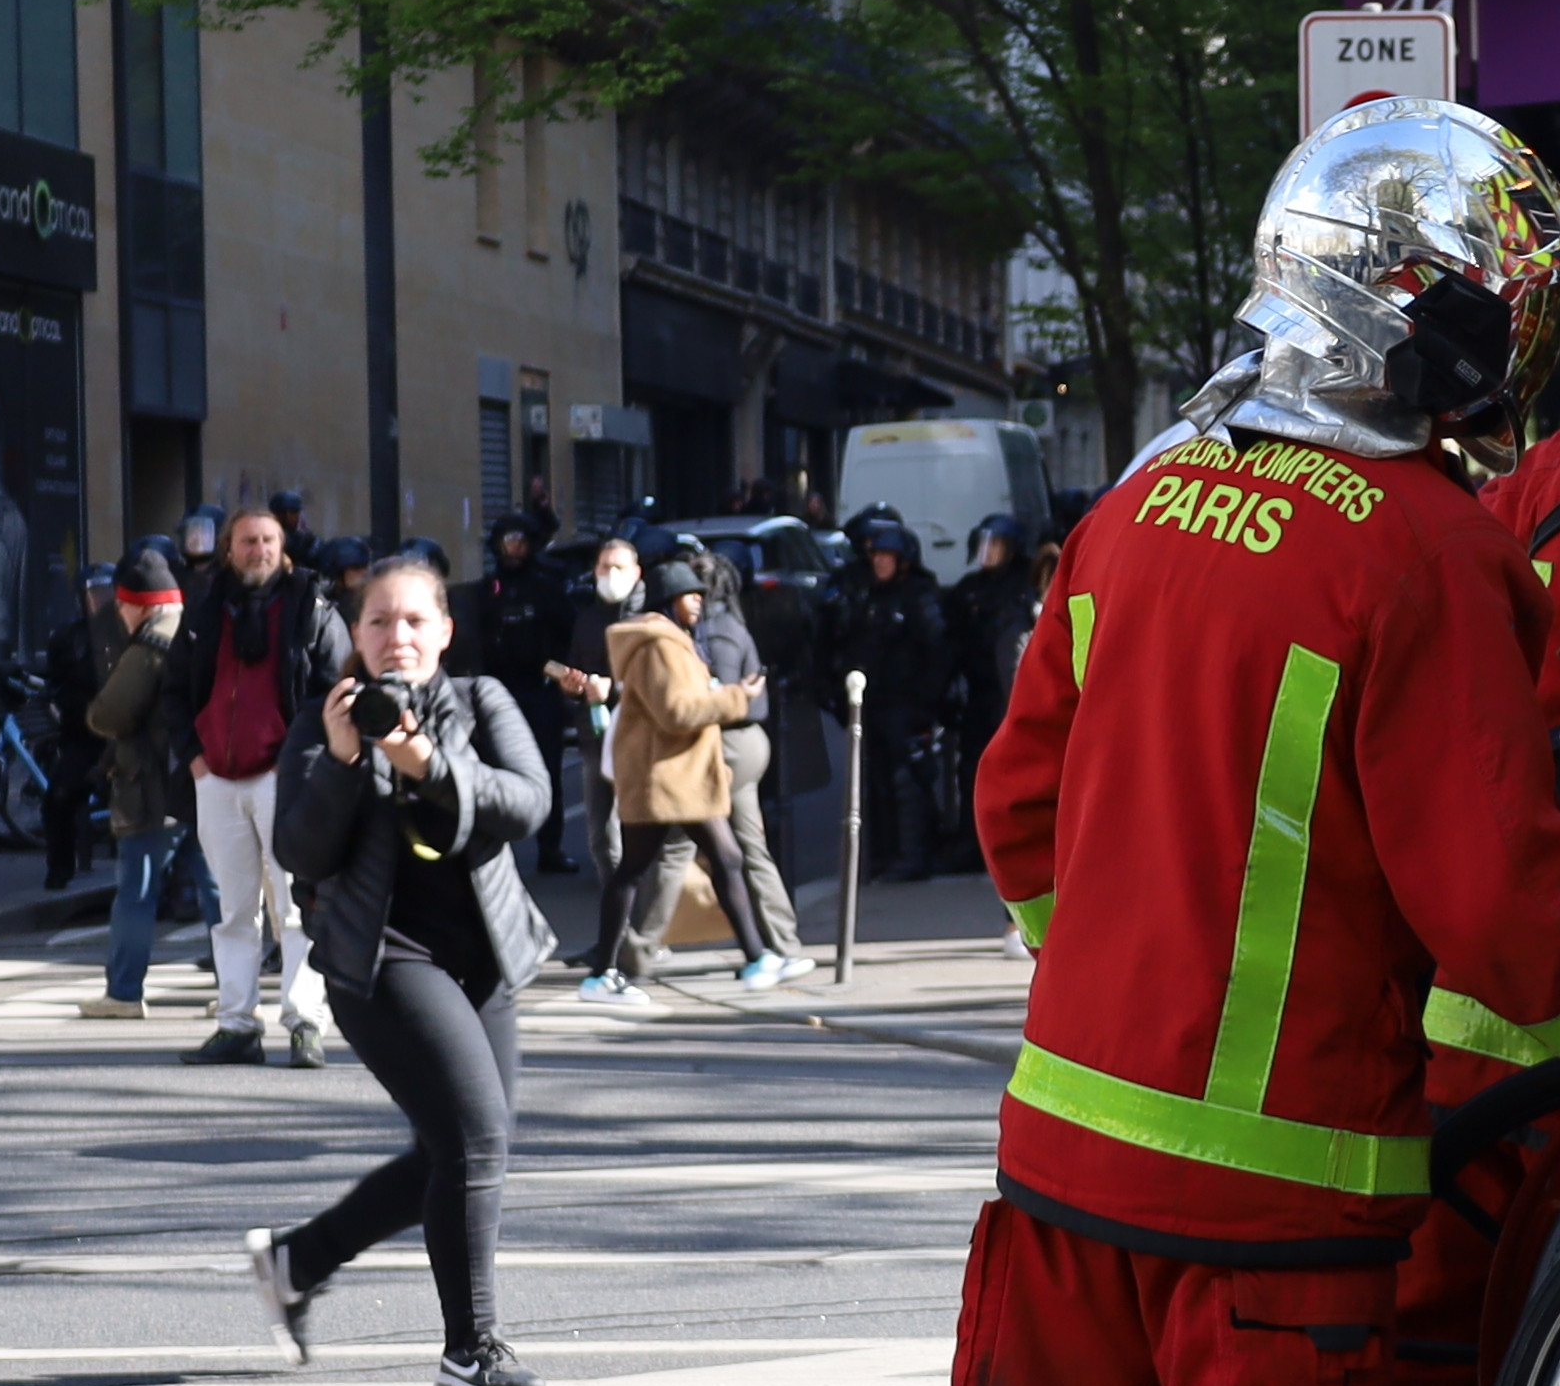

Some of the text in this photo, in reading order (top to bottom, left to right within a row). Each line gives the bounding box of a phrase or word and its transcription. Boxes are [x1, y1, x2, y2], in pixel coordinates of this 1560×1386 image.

[1337, 37, 1416, 63] ZONE
[1134, 474, 1294, 554] PARIS
[1233, 439, 1386, 523] POMPIERS
